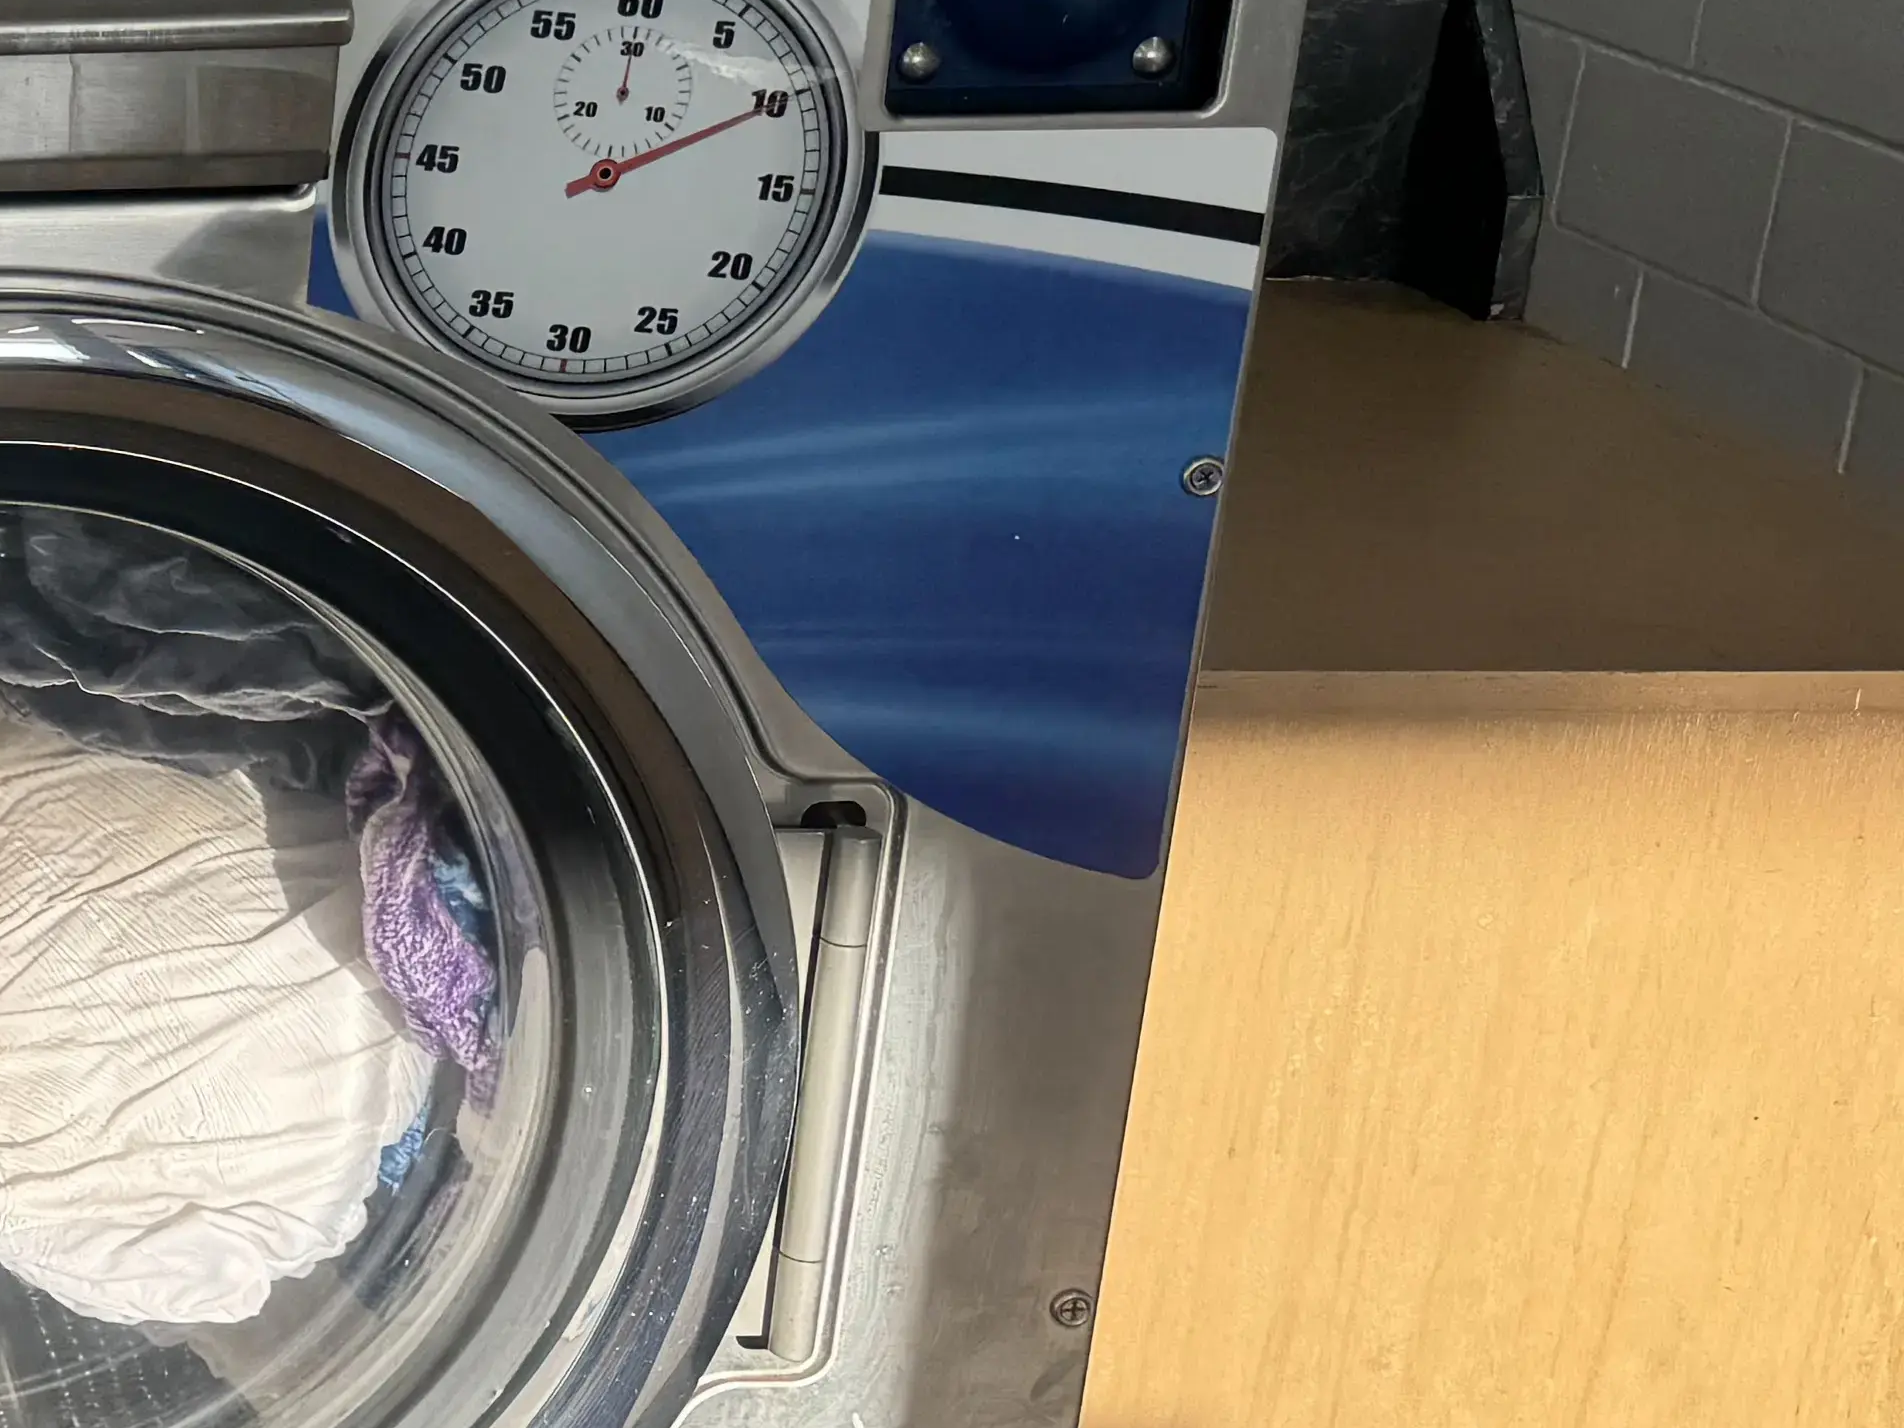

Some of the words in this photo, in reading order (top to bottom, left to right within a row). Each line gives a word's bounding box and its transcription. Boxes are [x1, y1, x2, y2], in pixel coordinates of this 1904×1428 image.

[531, 10, 576, 40] 55
[713, 21, 735, 48] 5
[619, 40, 645, 59] 30
[460, 63, 506, 93] 50
[573, 101, 597, 117] 20
[646, 107, 665, 122] 10
[750, 88, 789, 119] 10
[416, 144, 459, 173] 45
[758, 174, 794, 202] 15
[423, 227, 466, 255] 40
[708, 251, 753, 280] 20
[469, 290, 514, 318] 35
[634, 307, 678, 335] 25
[547, 325, 591, 353] 30
